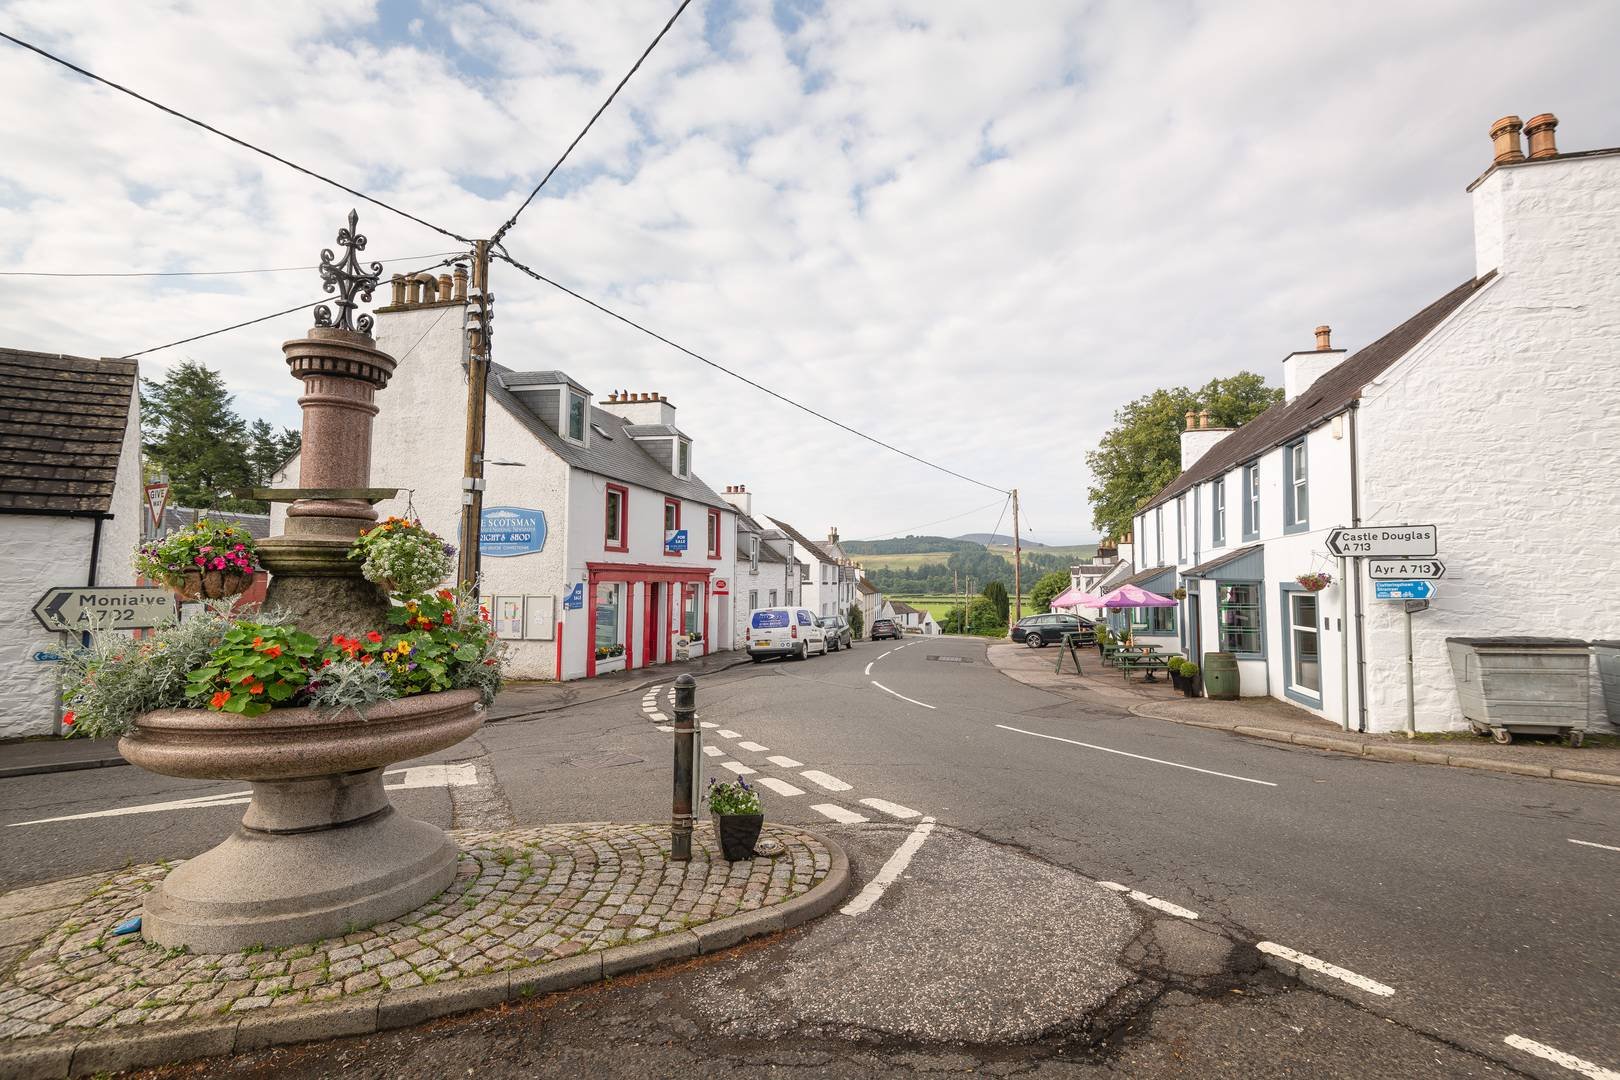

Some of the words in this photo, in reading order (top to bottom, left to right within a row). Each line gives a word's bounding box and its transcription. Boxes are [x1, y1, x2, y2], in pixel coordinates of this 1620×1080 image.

[151, 489, 165, 499] GIVE
[488, 518, 536, 528] SCOTSMAN
[510, 533, 531, 541] SHOP
[1342, 532, 1378, 541] Castle
[1382, 531, 1431, 541] Douglas
[1343, 543, 1351, 551] A
[1353, 543, 1371, 551] 713
[1375, 565, 1395, 575] Ayr
[1399, 565, 1408, 574] A
[1411, 564, 1431, 574] 713
[79, 593, 166, 607] Moniaive
